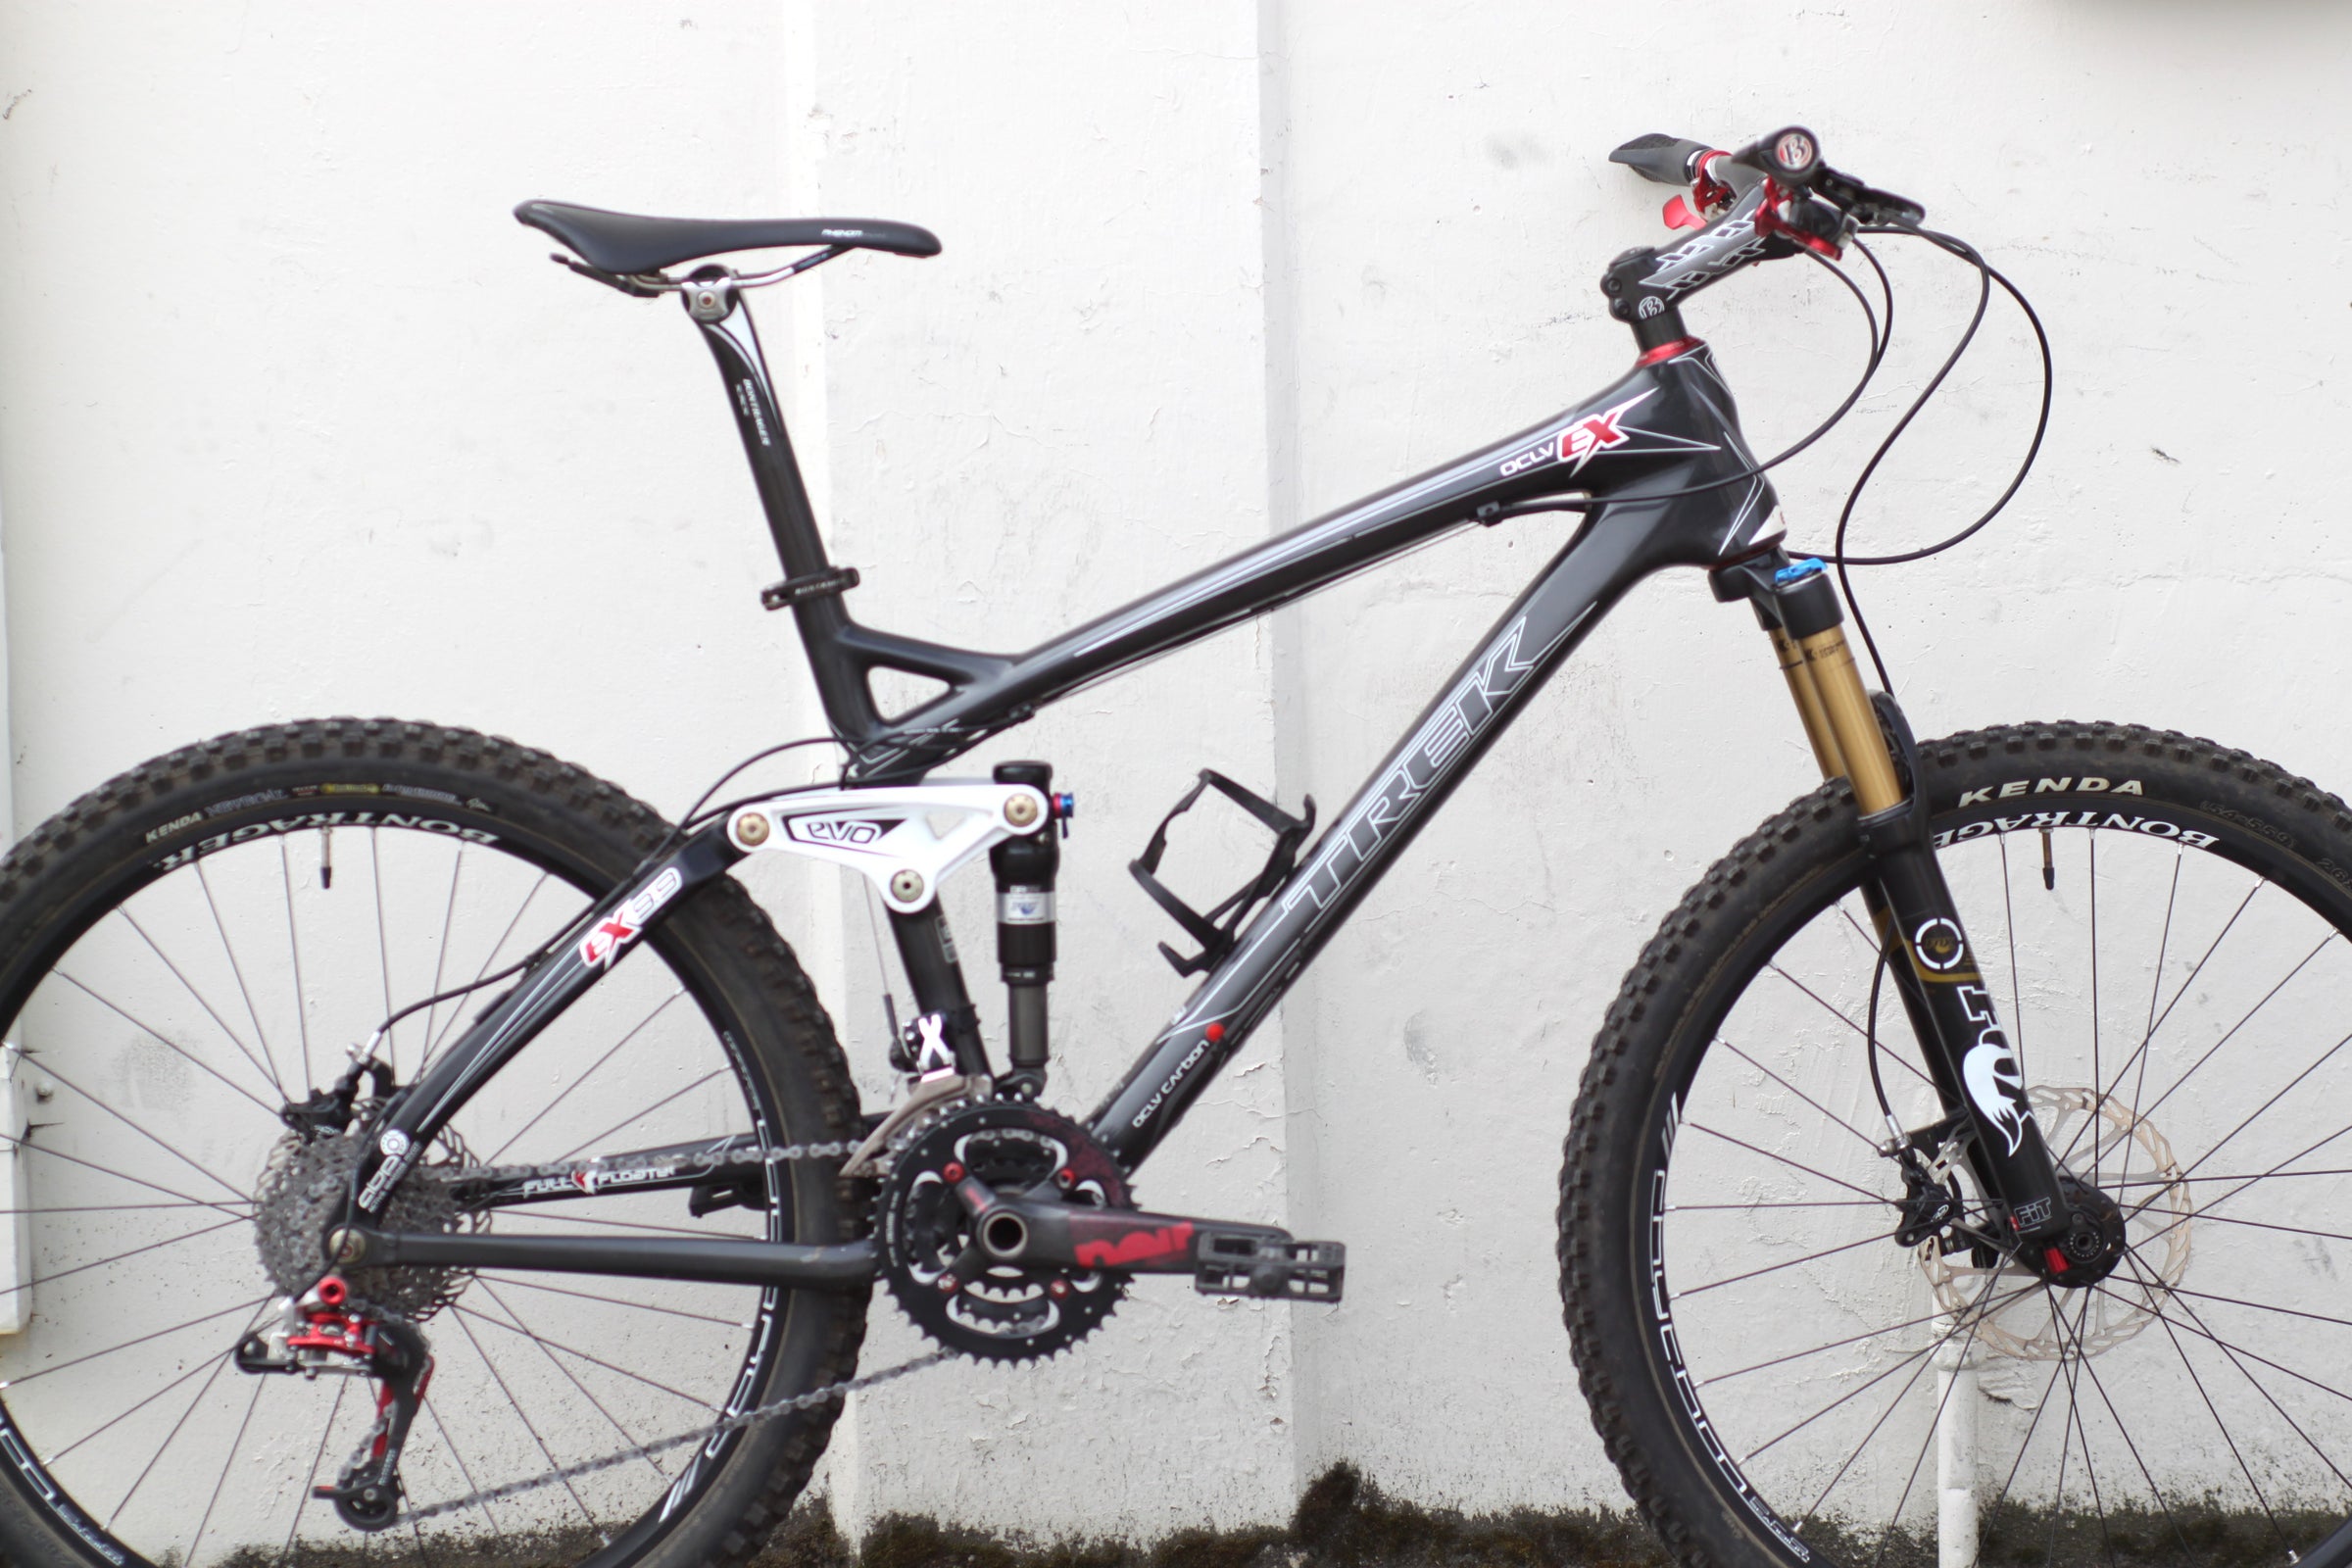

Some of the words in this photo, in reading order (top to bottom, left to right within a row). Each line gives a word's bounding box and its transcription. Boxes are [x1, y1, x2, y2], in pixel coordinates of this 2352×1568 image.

[1499, 442, 1554, 476] OCLV
[1556, 398, 1642, 474] EX
[1282, 616, 1534, 909] TREK
[1958, 776, 2144, 808] KENDA
[145, 811, 203, 844] KENDA
[161, 811, 501, 871] BONTRAGER
[1933, 811, 2220, 851] BONTRAGE
[1132, 1093, 1163, 1128] OCLV
